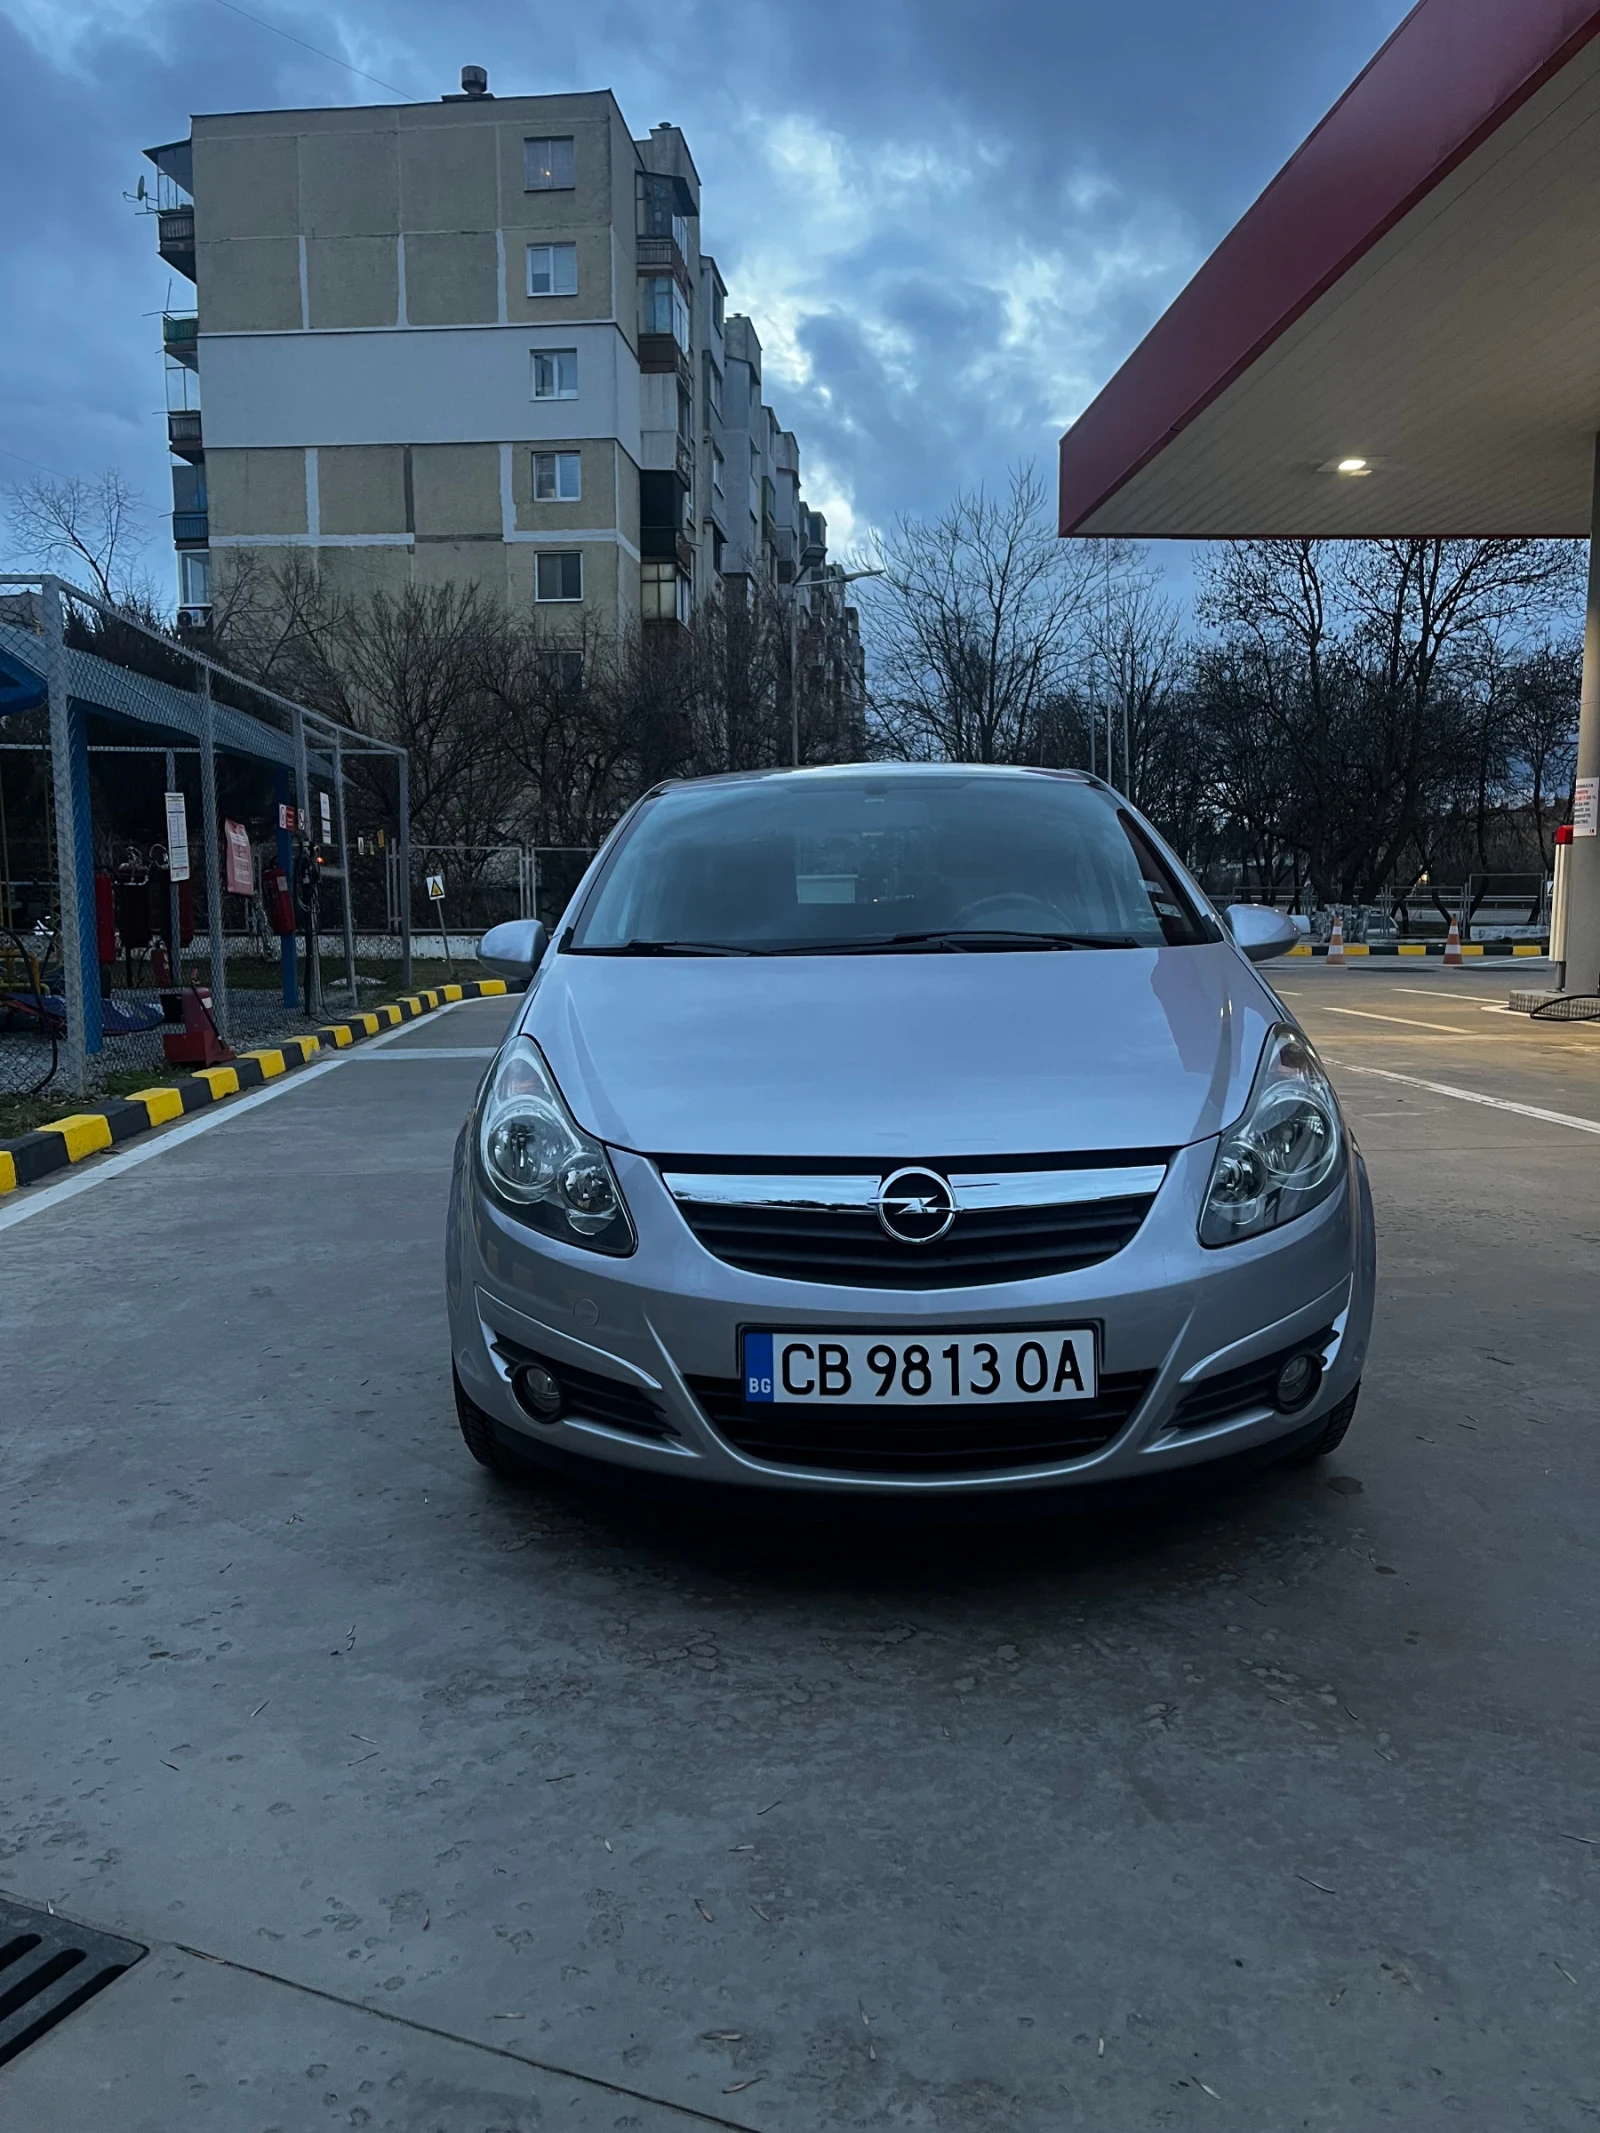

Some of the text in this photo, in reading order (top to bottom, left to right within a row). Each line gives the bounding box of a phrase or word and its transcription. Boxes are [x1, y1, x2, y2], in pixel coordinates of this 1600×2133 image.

[749, 1378, 770, 1393] BG
[781, 1342, 852, 1396] CB
[867, 1341, 1001, 1396] 9813
